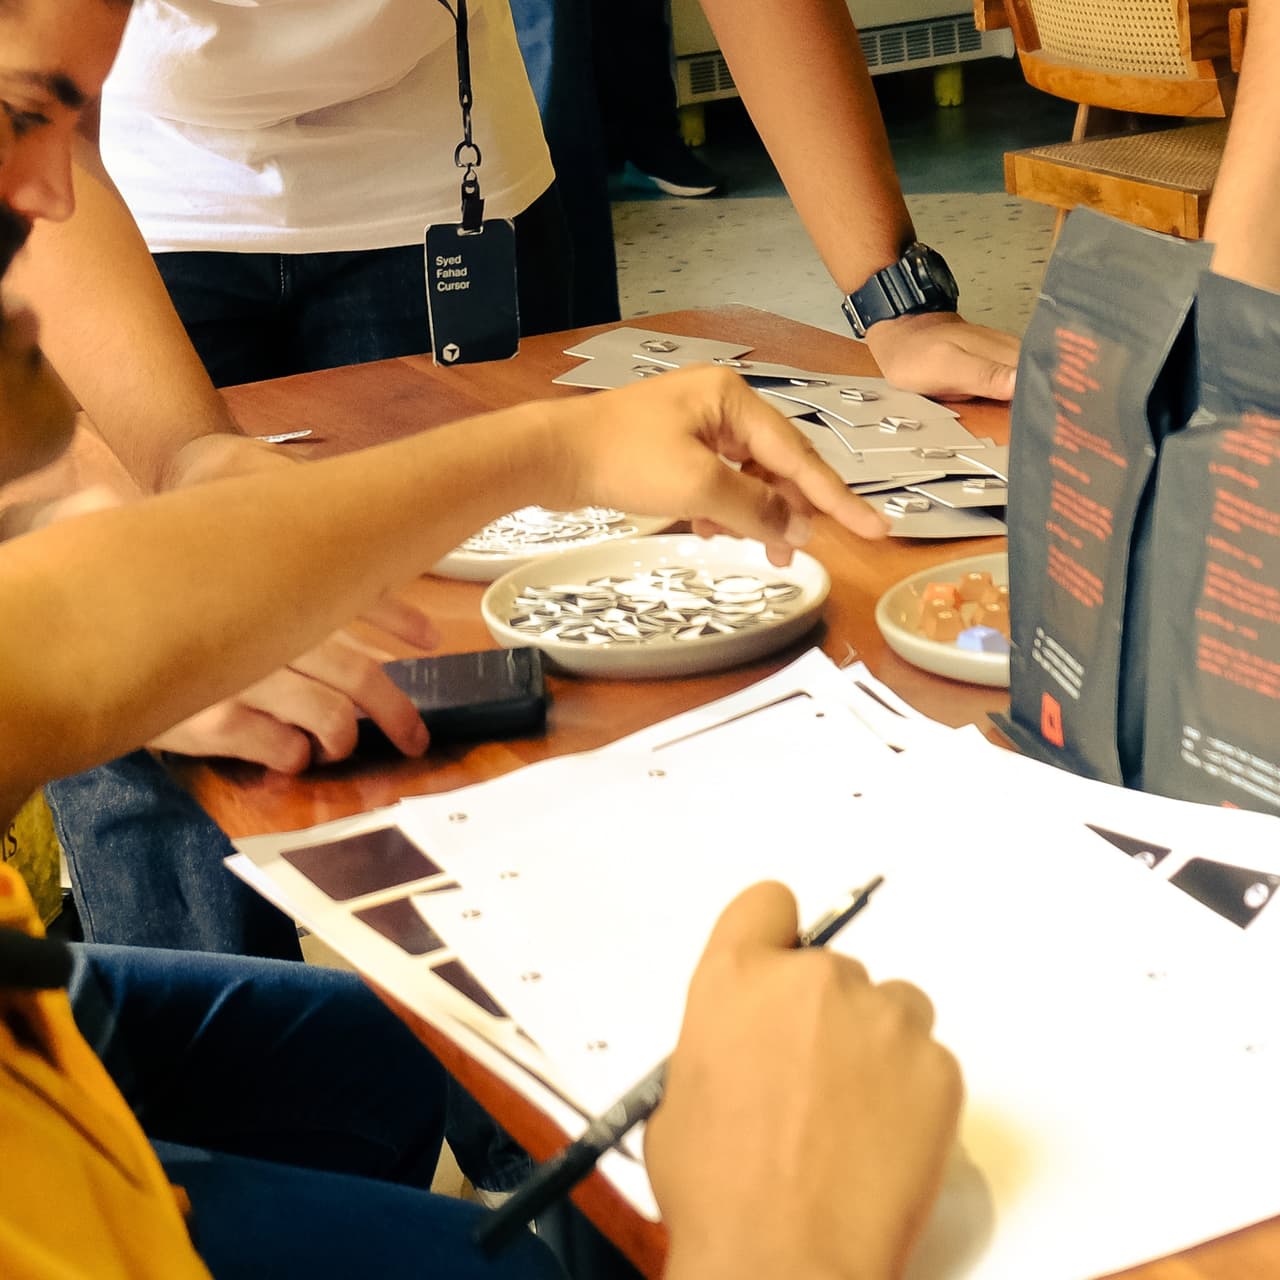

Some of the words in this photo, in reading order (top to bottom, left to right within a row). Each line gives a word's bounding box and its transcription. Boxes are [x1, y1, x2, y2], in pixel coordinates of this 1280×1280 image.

[436, 255, 462, 267] Syed
[436, 267, 467, 278] Fahad
[437, 281, 470, 291] Cursor
